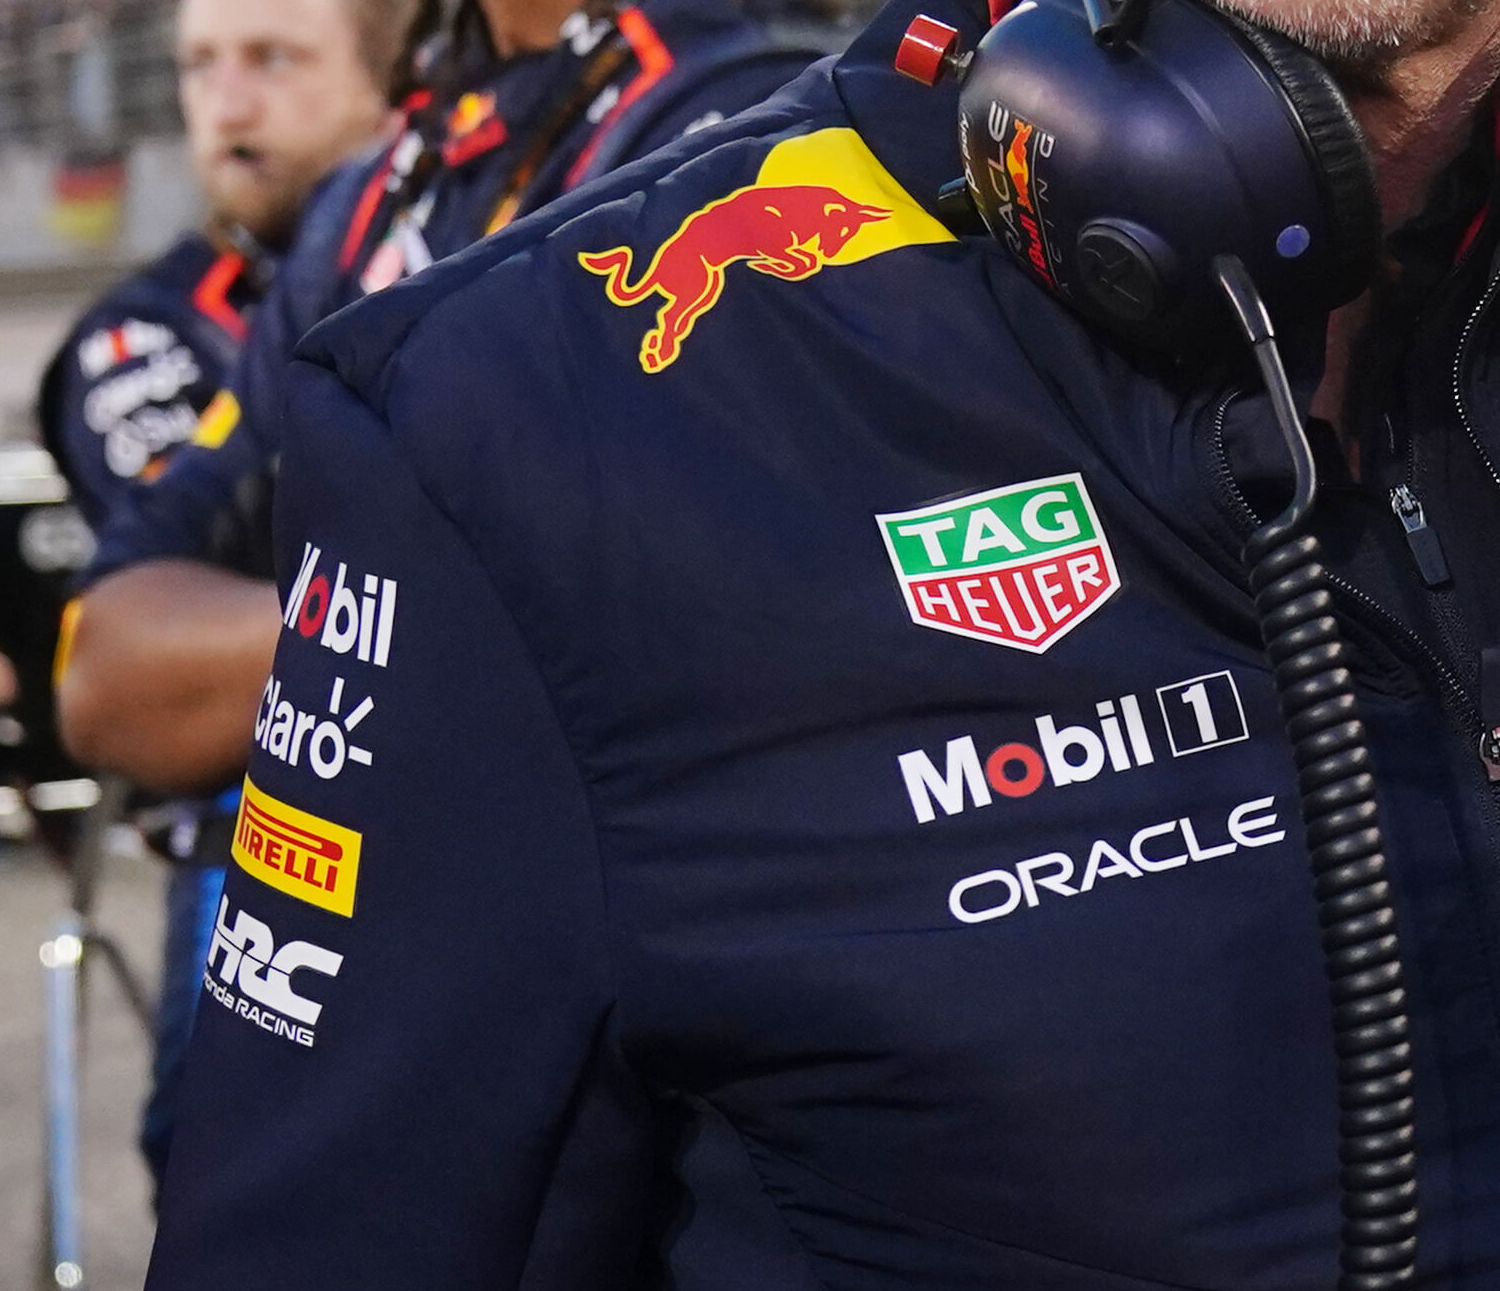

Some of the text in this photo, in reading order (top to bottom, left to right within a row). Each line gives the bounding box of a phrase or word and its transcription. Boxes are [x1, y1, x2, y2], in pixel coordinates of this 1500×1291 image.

[898, 491, 1080, 566] TAG
[284, 542, 397, 667] Mobil
[916, 553, 1103, 640] HEUER
[254, 675, 345, 779] Claro
[897, 683, 1218, 824] Mobil 1
[238, 796, 343, 893] PIRELLI
[949, 796, 1286, 924] ORACLE
[208, 894, 344, 1026] HRC
[235, 997, 315, 1048] RACING
